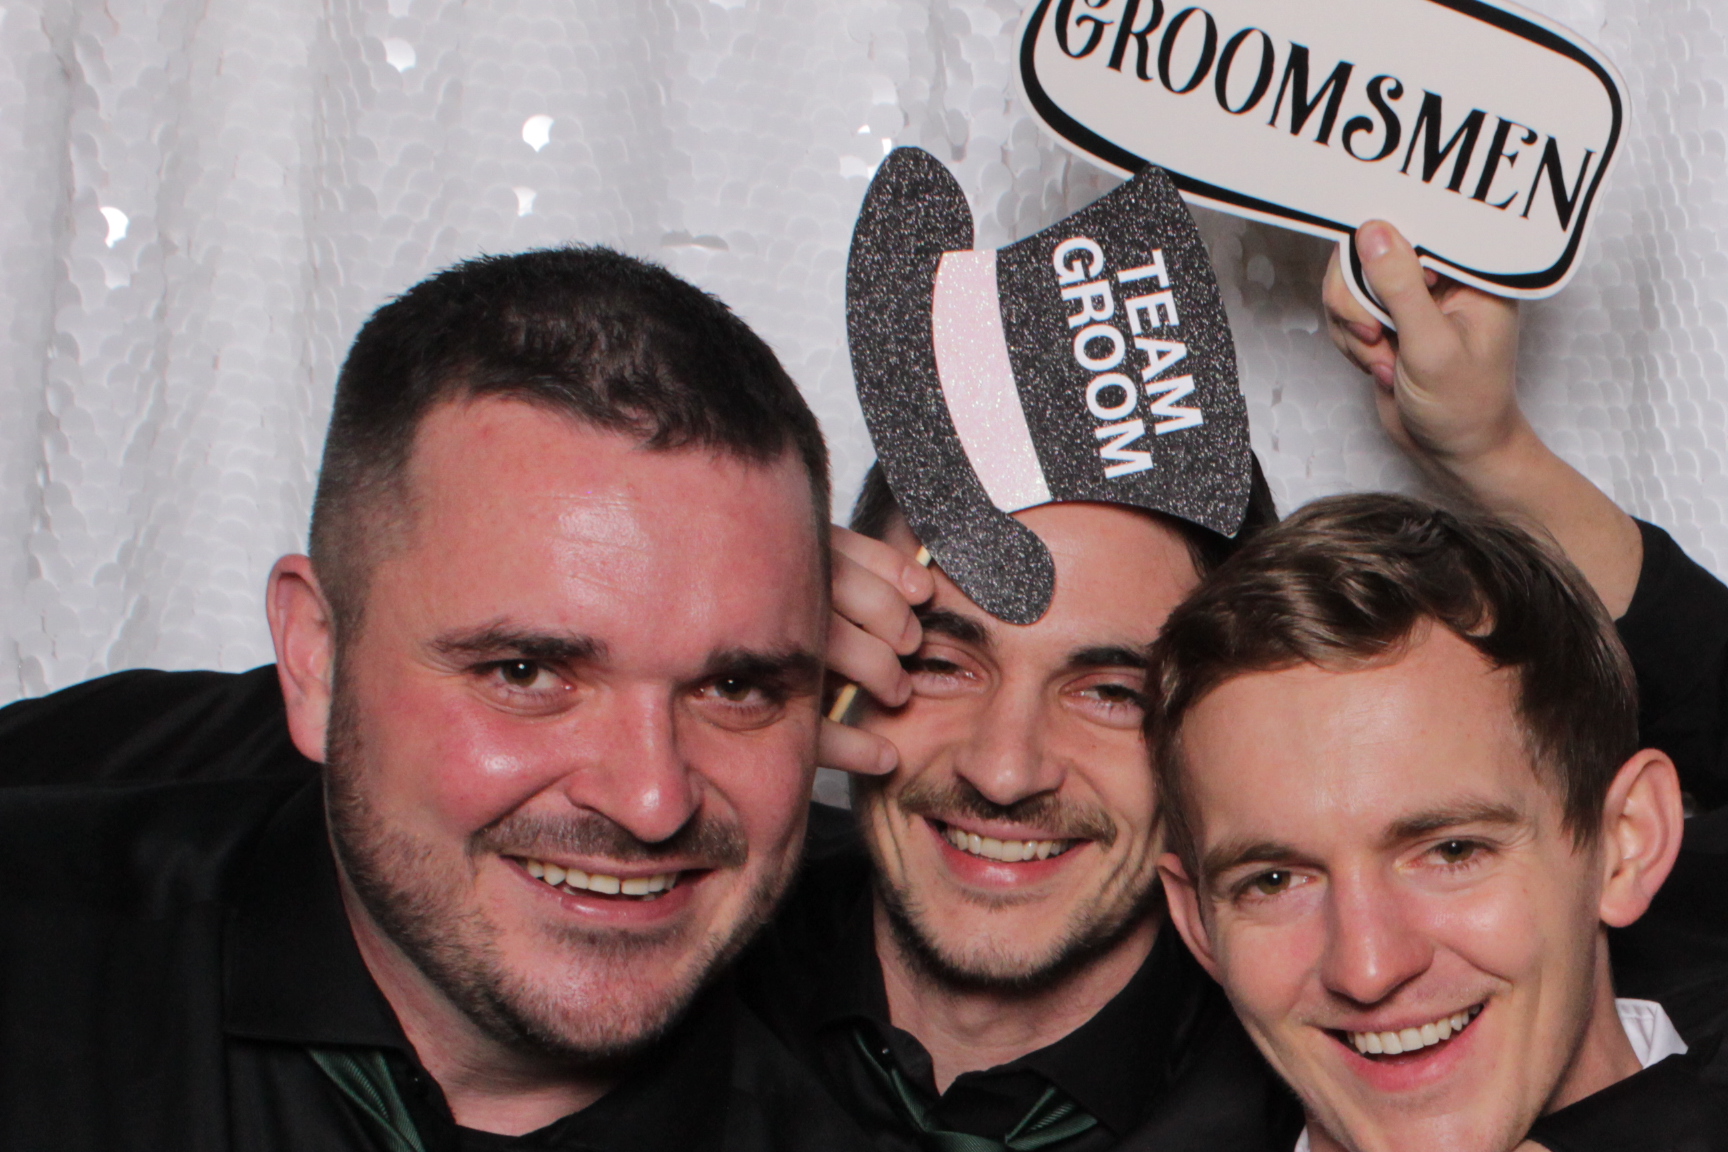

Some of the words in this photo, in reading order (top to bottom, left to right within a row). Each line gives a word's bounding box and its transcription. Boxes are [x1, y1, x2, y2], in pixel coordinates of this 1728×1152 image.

[1055, 0, 1598, 233] GROOMSMEN
[1052, 236, 1154, 479] GROOM
[1117, 248, 1204, 435] TEAM
